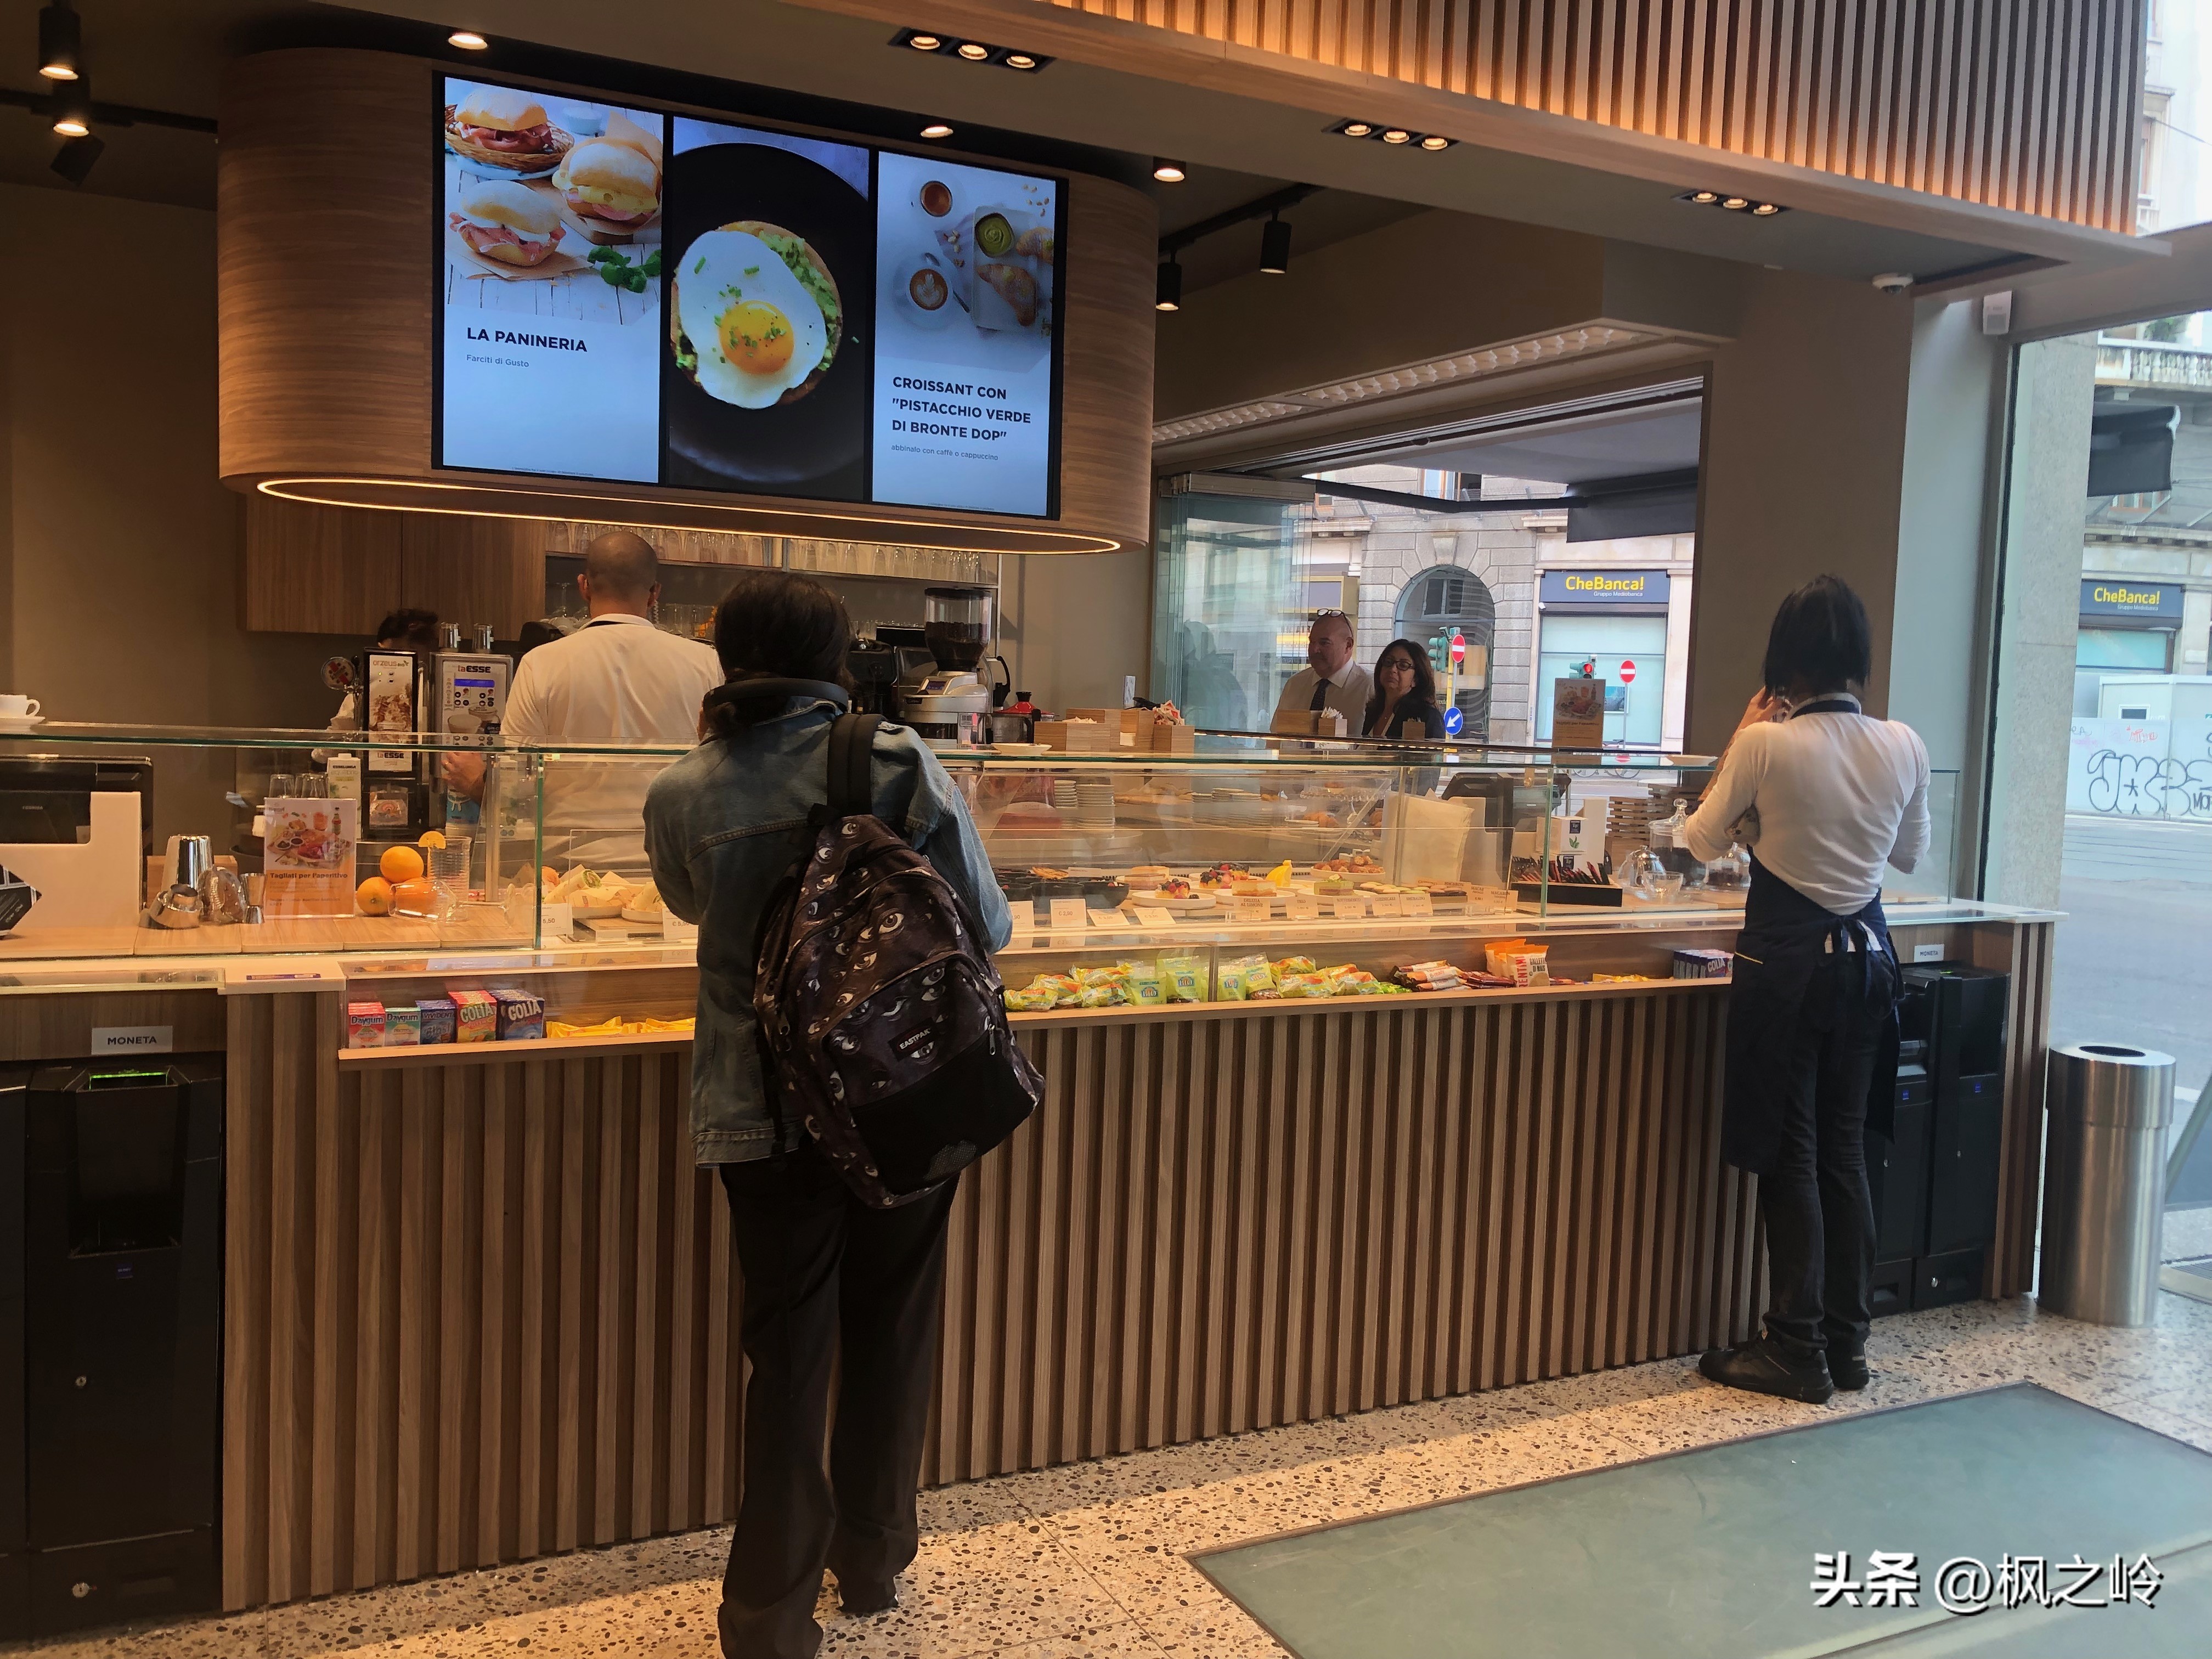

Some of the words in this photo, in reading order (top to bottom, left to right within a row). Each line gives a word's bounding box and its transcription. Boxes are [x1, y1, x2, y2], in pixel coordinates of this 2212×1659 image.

[467, 327, 490, 342] LA
[495, 330, 588, 352] PANINERIA
[466, 354, 493, 364] Farciti
[495, 357, 503, 365] di
[505, 358, 529, 368] Gusto
[893, 376, 974, 396] CROISSANT
[977, 386, 1006, 400] CON
[892, 398, 982, 418] "PISTACCHIO
[986, 408, 1031, 424] VERDE
[892, 420, 906, 432] DI
[911, 422, 968, 438] BRONTE
[971, 428, 1007, 441] DOP"
[961, 452, 998, 461] cappuccino
[1565, 575, 1644, 590] CheBanca!
[2094, 587, 2160, 605] CheBanca!
[387, 1013, 418, 1023] Daygum
[507, 1000, 543, 1021] GOLIA
[351, 1016, 383, 1025] Daygum
[107, 1036, 157, 1045] MONETA
[899, 1028, 931, 1049] EASTPAK
